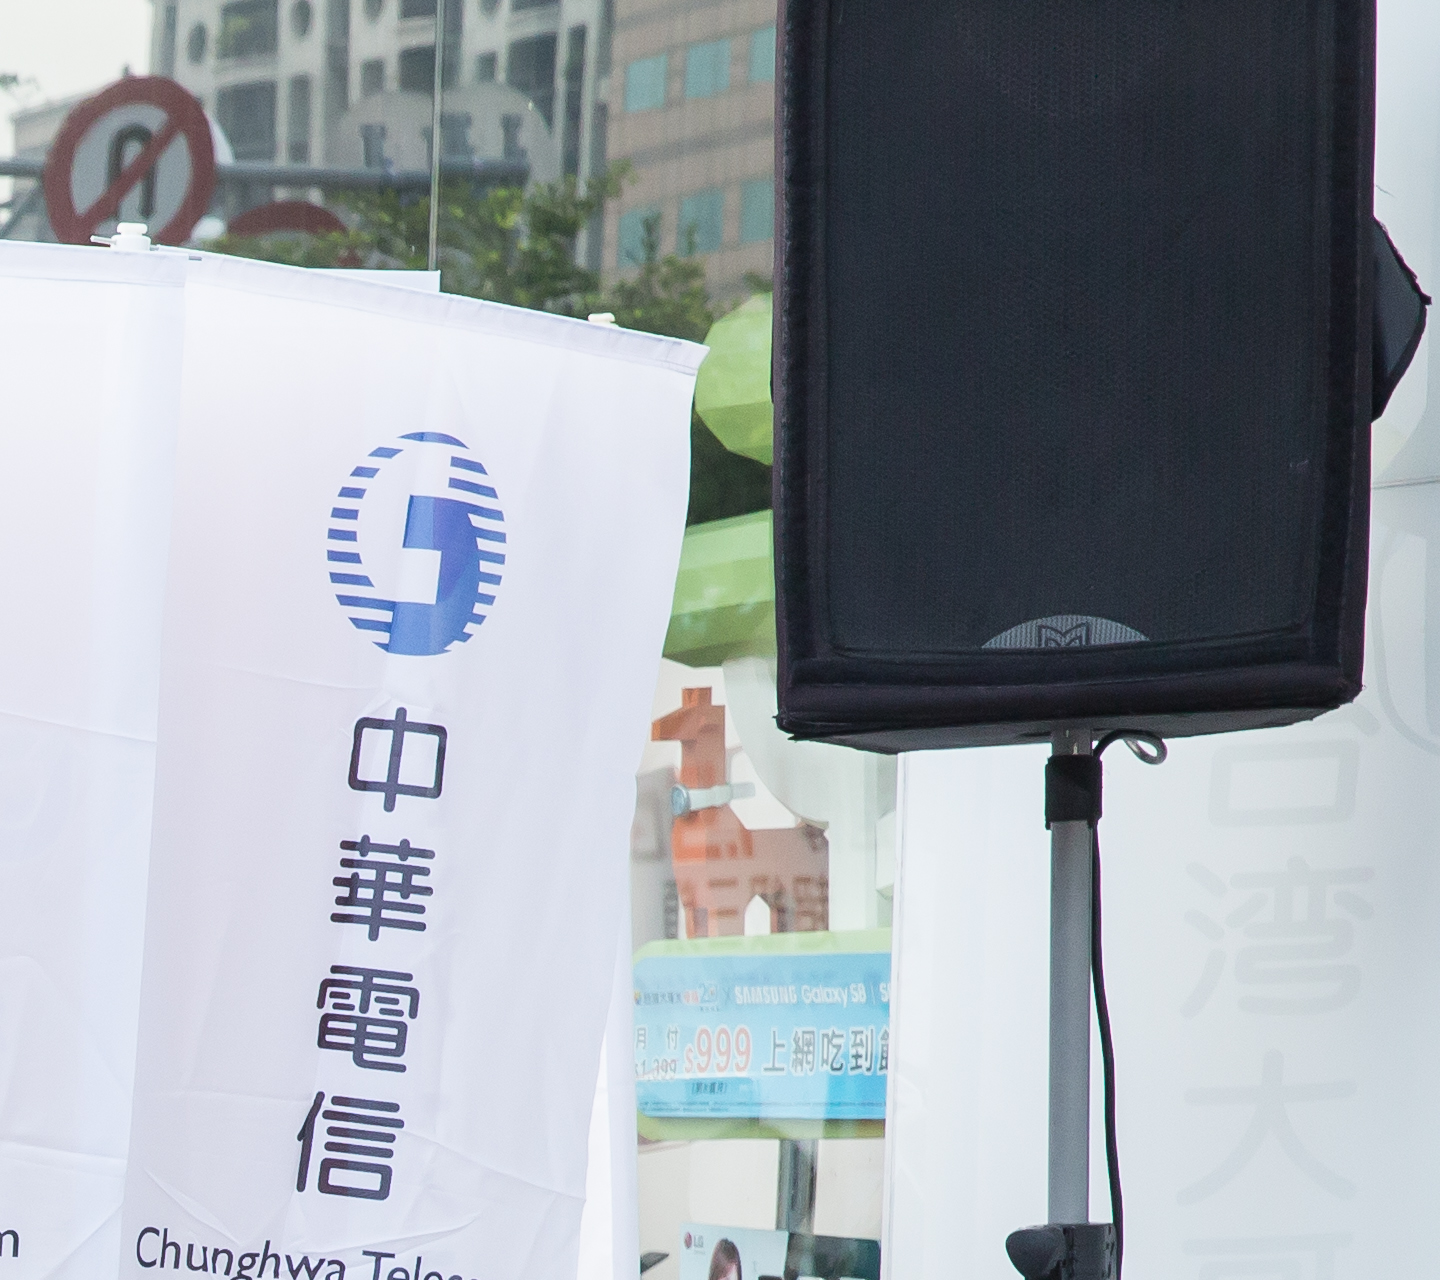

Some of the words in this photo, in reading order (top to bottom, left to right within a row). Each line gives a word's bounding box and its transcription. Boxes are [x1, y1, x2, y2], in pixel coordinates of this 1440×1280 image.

[297, 707, 447, 1200] 中華電信
[735, 985, 798, 1005] SAMSUNG
[801, 984, 848, 1008] Galaxy
[684, 1027, 751, 1074] $999
